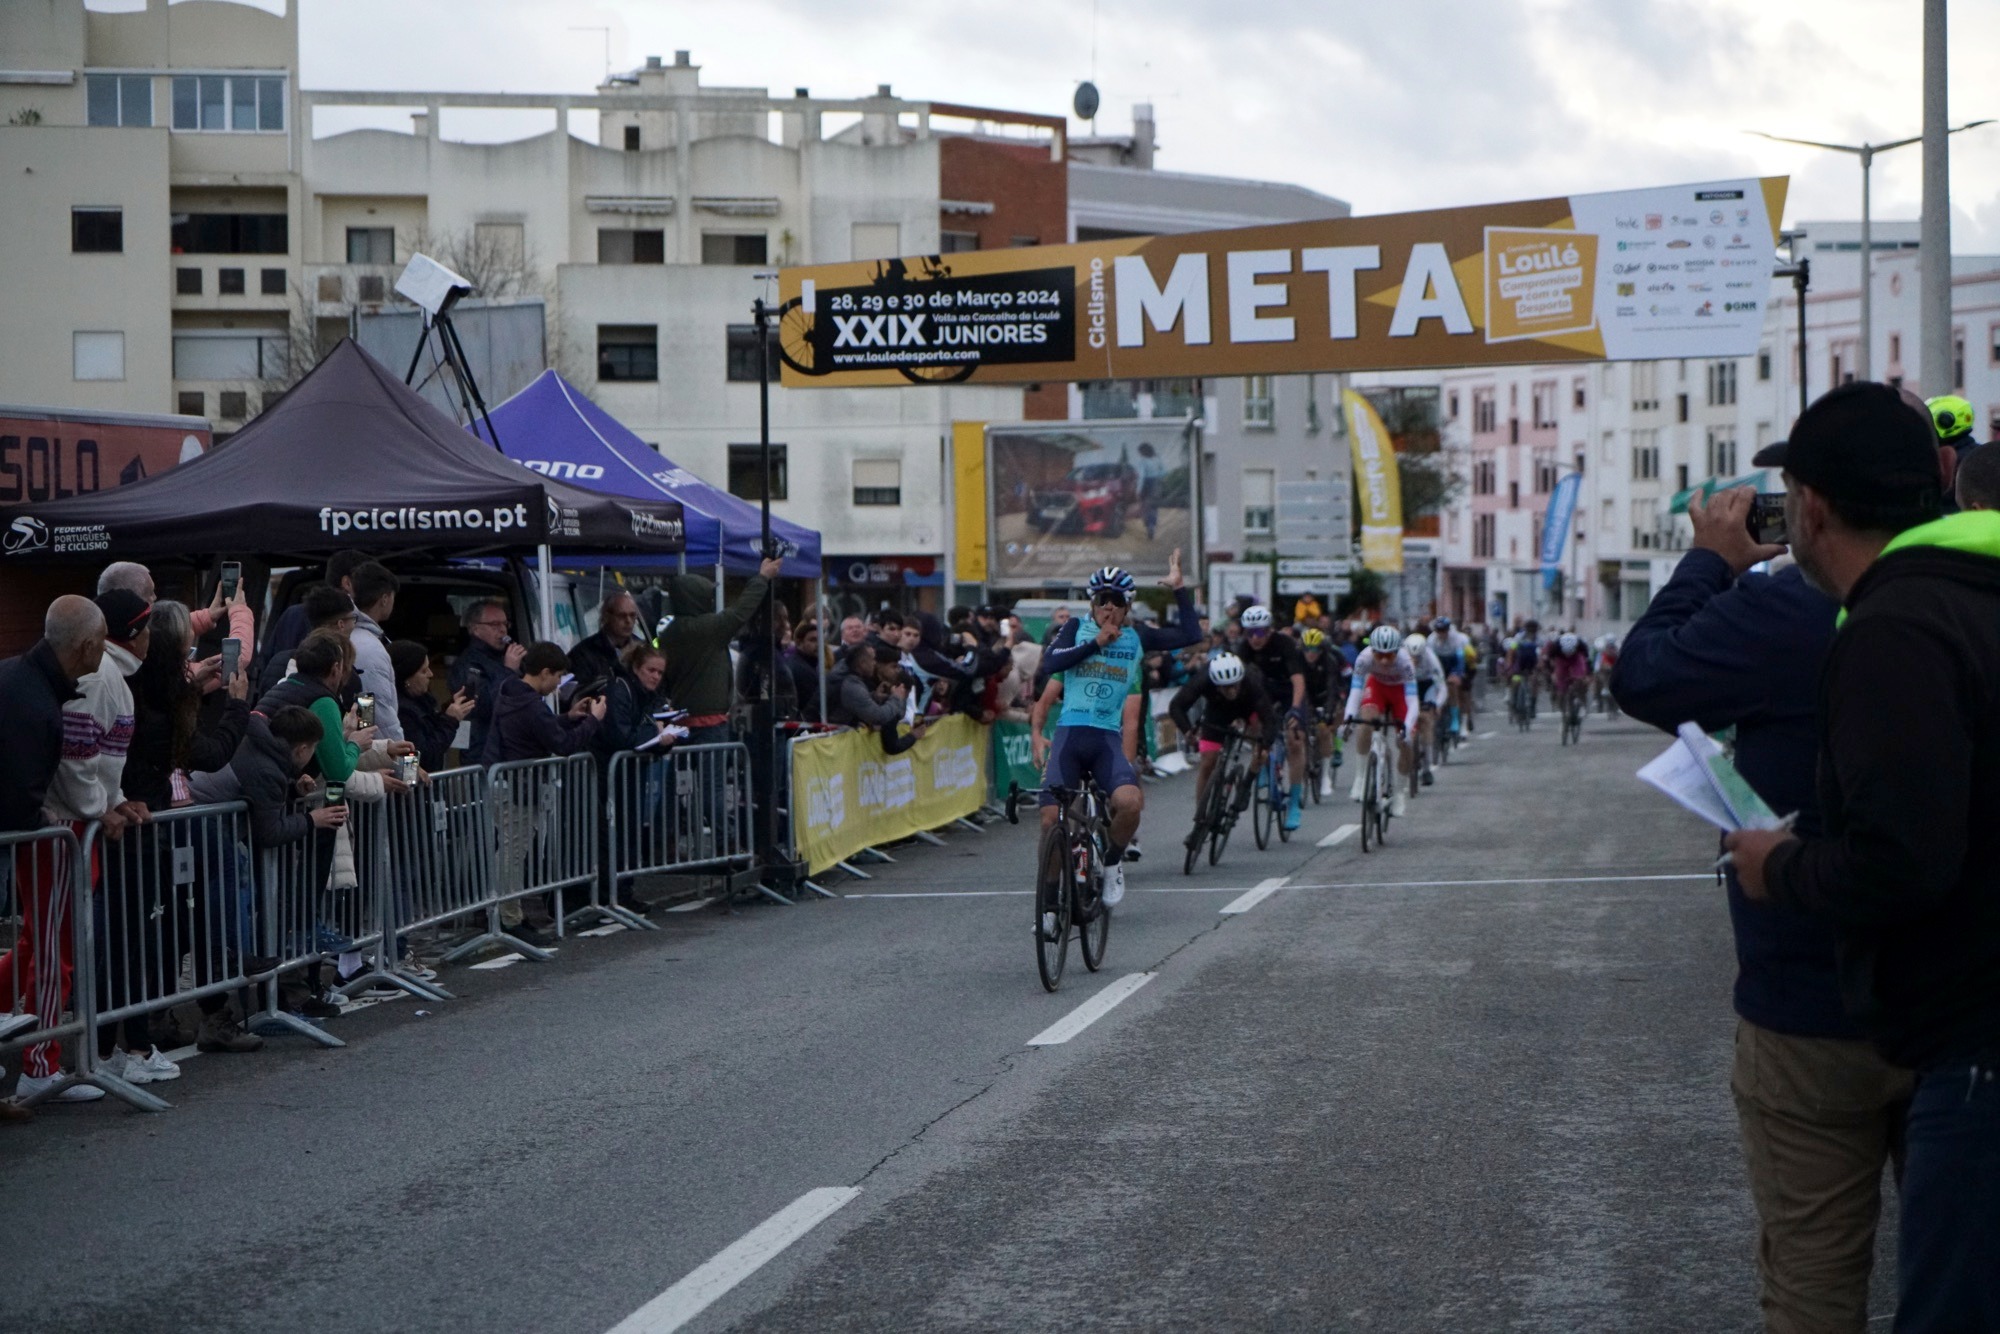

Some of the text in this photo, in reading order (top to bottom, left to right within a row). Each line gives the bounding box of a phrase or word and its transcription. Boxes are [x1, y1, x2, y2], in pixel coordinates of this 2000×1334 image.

[1498, 242, 1579, 275] Loulé
[1503, 273, 1579, 293] Compromisso
[831, 290, 1060, 311] 28, 29 e 30 de Março 2024
[1088, 257, 1105, 349] Ciclismo
[1114, 242, 1475, 348] META
[932, 310, 1061, 323] Volta ao Concelho de Loulé
[1733, 301, 1757, 311] GNR
[832, 314, 927, 348] XXIX
[932, 323, 1048, 346] JUNIORES
[833, 349, 981, 364] www.louledesporto.com
[318, 503, 527, 536] fpciclismo.pt
[54, 532, 111, 543] PORTUGUESA
[54, 541, 109, 552] DE CICLISMO
